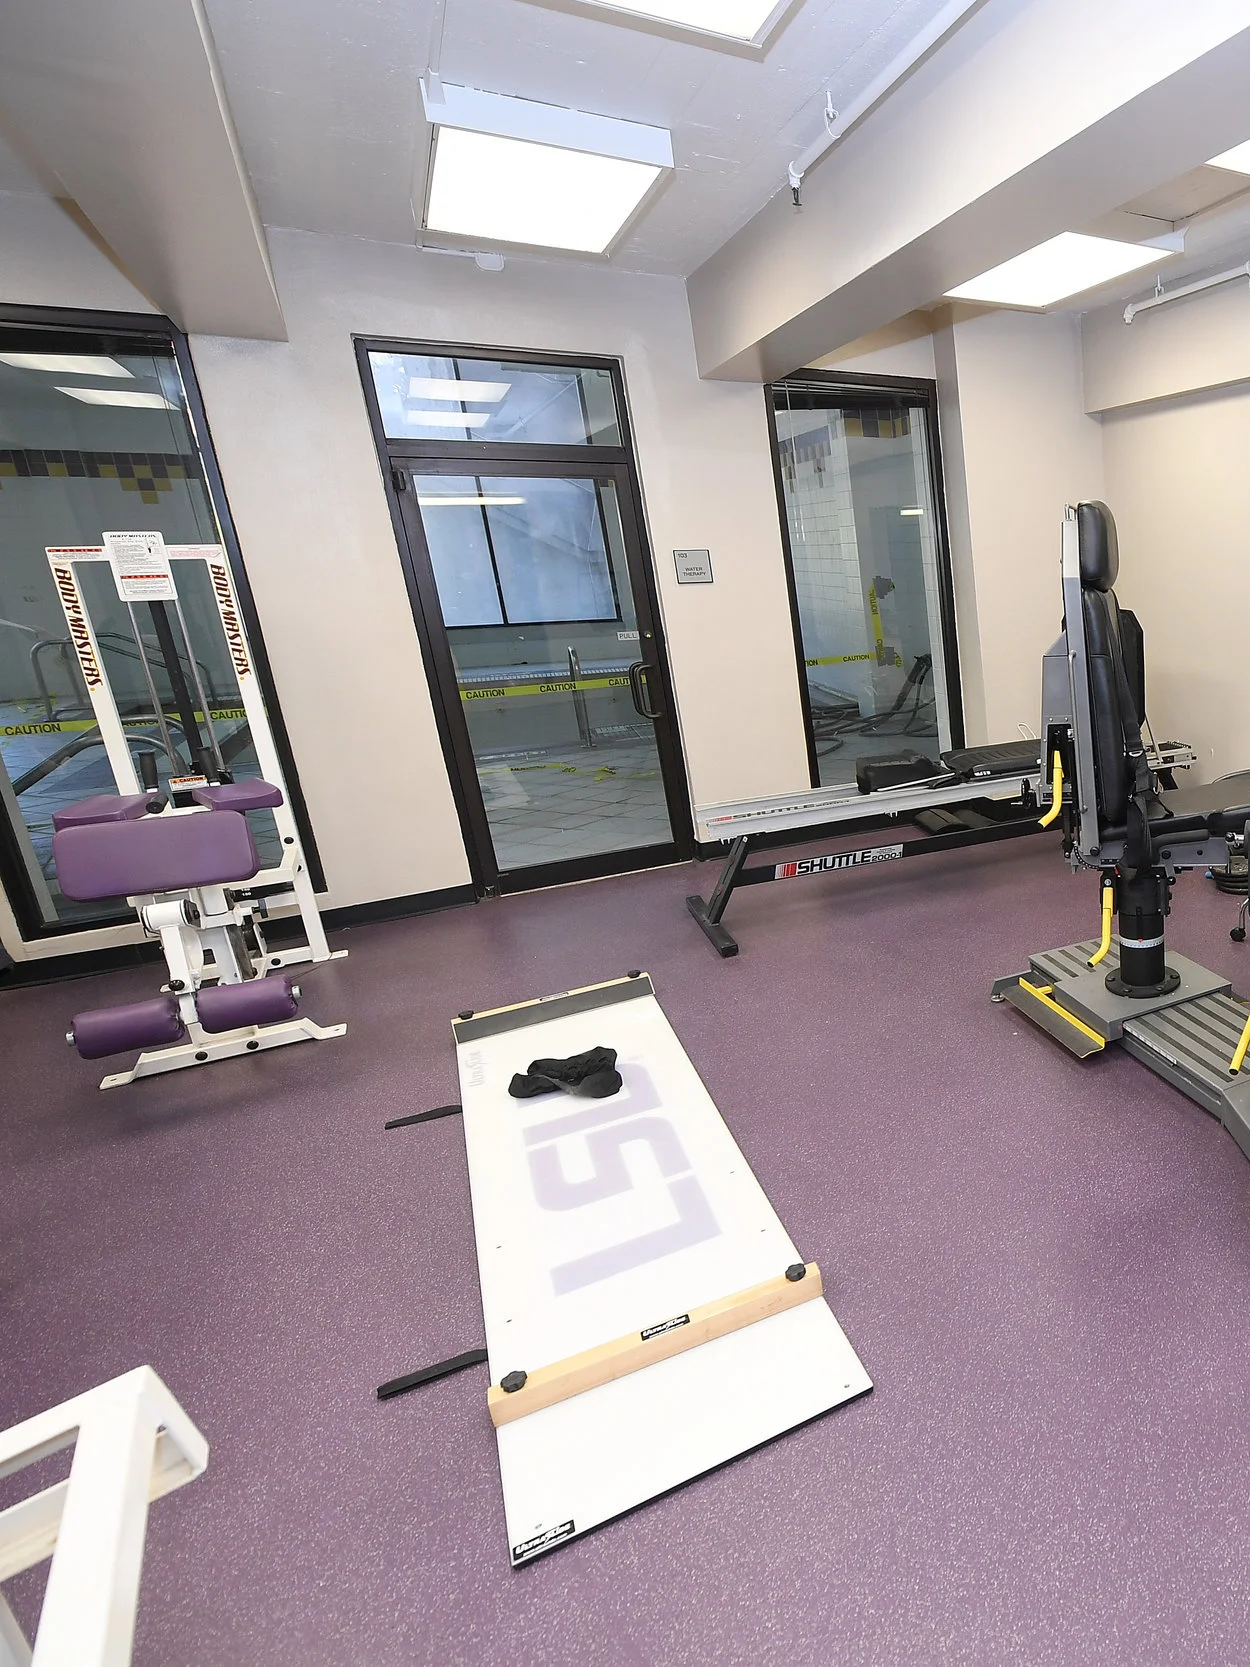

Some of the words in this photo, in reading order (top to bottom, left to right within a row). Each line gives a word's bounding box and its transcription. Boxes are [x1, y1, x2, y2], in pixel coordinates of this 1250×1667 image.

[842, 654, 870, 663] CAUTION
[466, 688, 505, 700] CAUTION
[539, 682, 577, 693] CAUTION
[608, 677, 630, 686] CAUT
[4, 723, 61, 736] CAUTION
[210, 709, 247, 720] CAUTI
[797, 851, 872, 875] SHUTTLE
